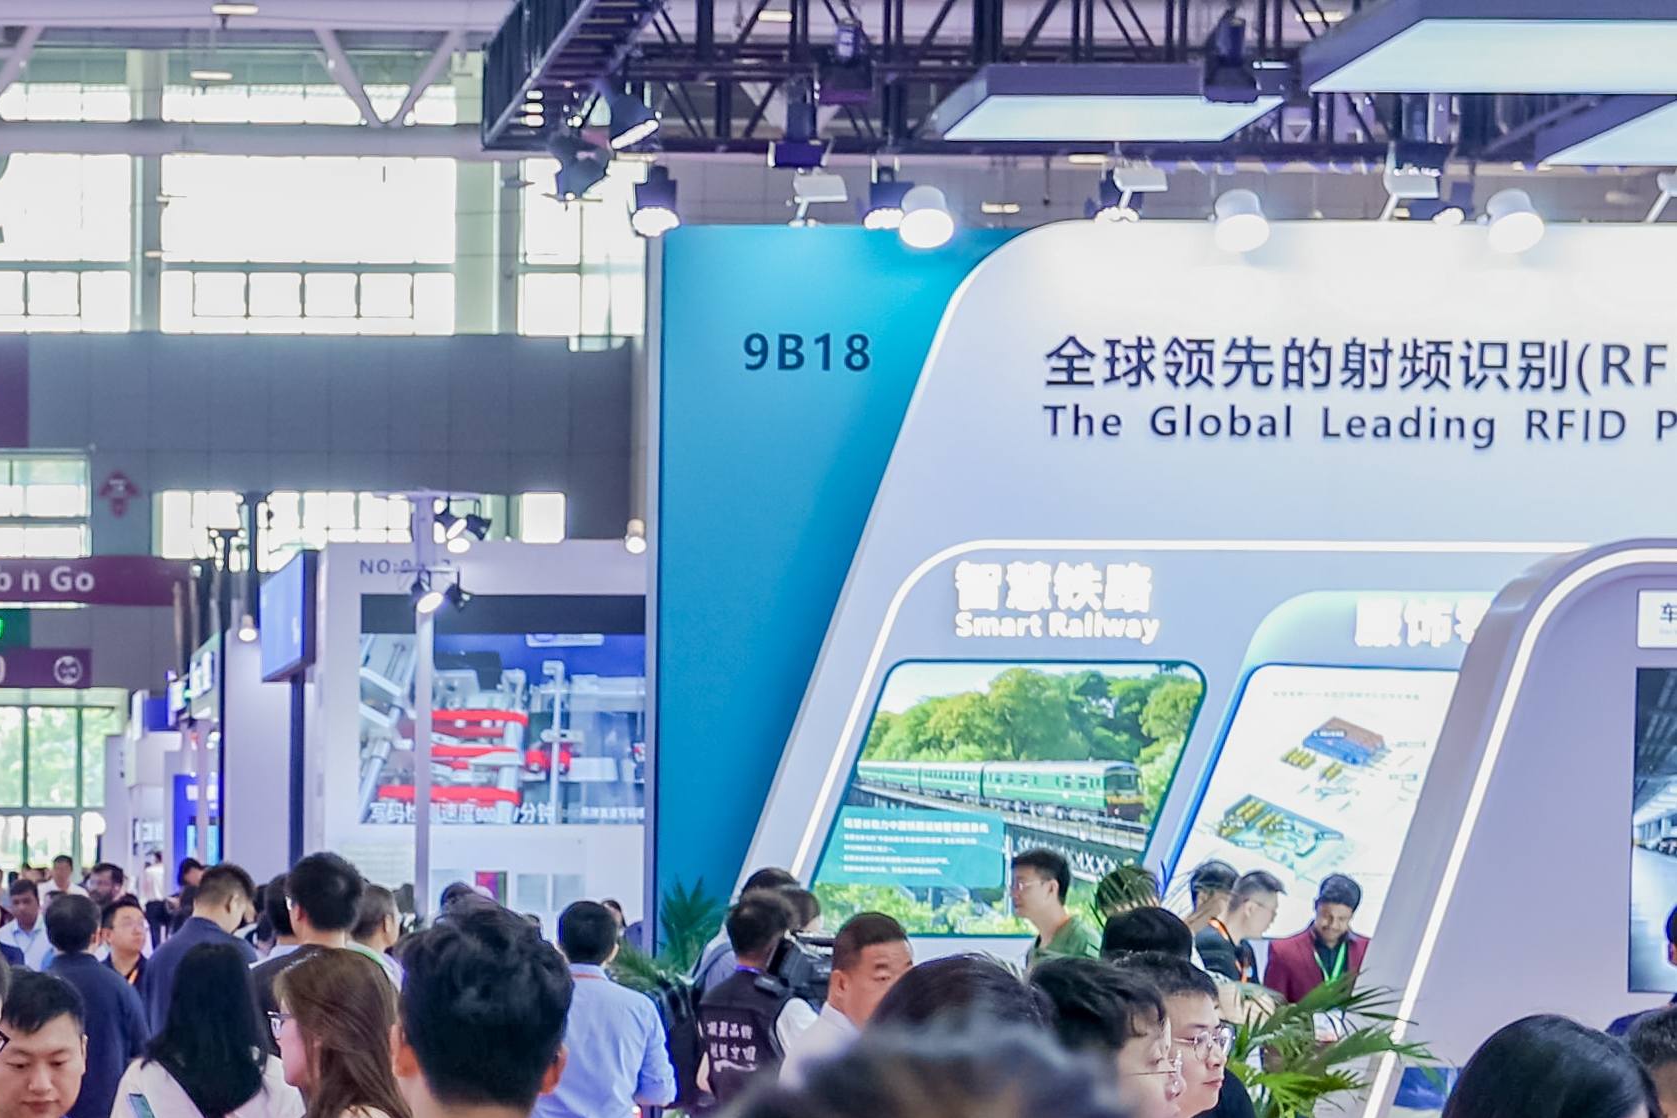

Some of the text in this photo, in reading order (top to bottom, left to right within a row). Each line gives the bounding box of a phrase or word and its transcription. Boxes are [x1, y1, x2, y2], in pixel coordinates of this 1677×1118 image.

[743, 332, 871, 372] 9B18
[1043, 403, 1122, 437] The
[1150, 403, 1291, 437] Global
[1321, 404, 1496, 450] Leading
[1526, 408, 1627, 442] RFID
[22, 571, 41, 592] n
[49, 565, 95, 592] Go
[955, 561, 1153, 613] 智慧铁路
[955, 611, 1160, 645] Smart Railway
